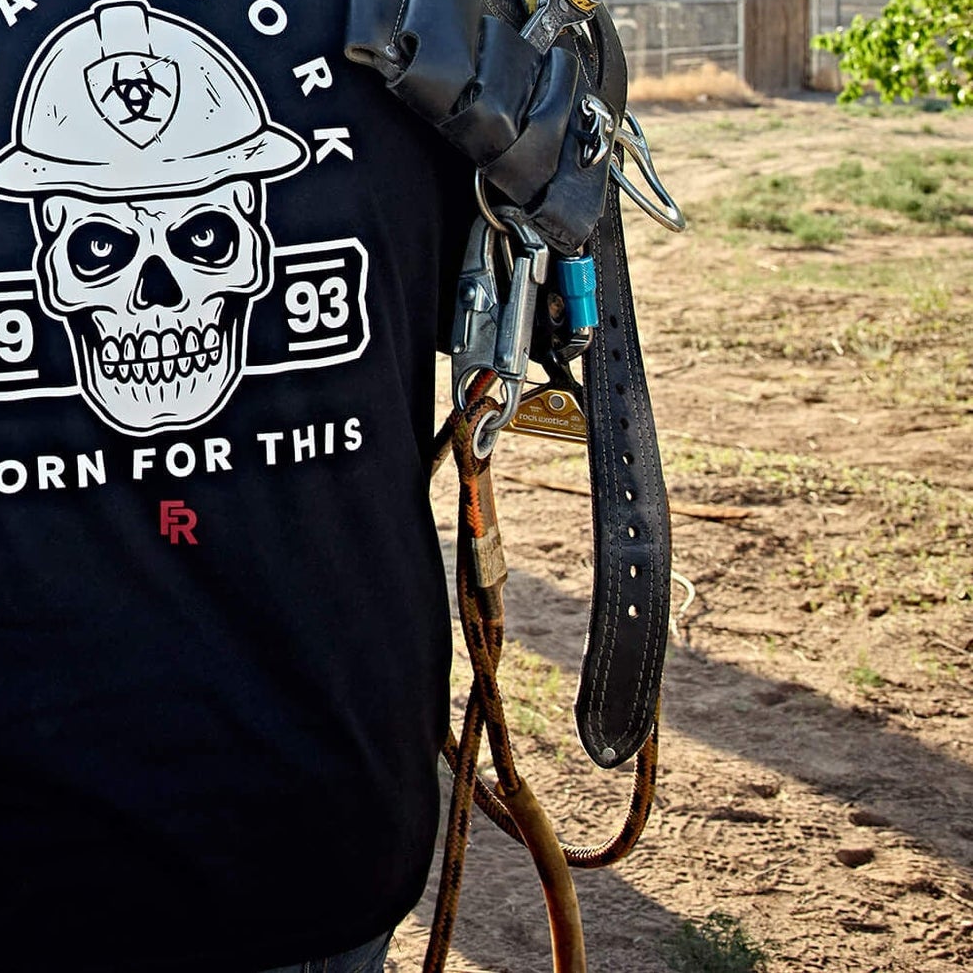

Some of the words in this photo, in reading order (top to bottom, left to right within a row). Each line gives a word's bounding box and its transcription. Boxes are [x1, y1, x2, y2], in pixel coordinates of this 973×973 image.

[285, 276, 350, 334] 93
[132, 437, 233, 480] FOR
[256, 417, 363, 465] THIS
[159, 499, 199, 545] FR
